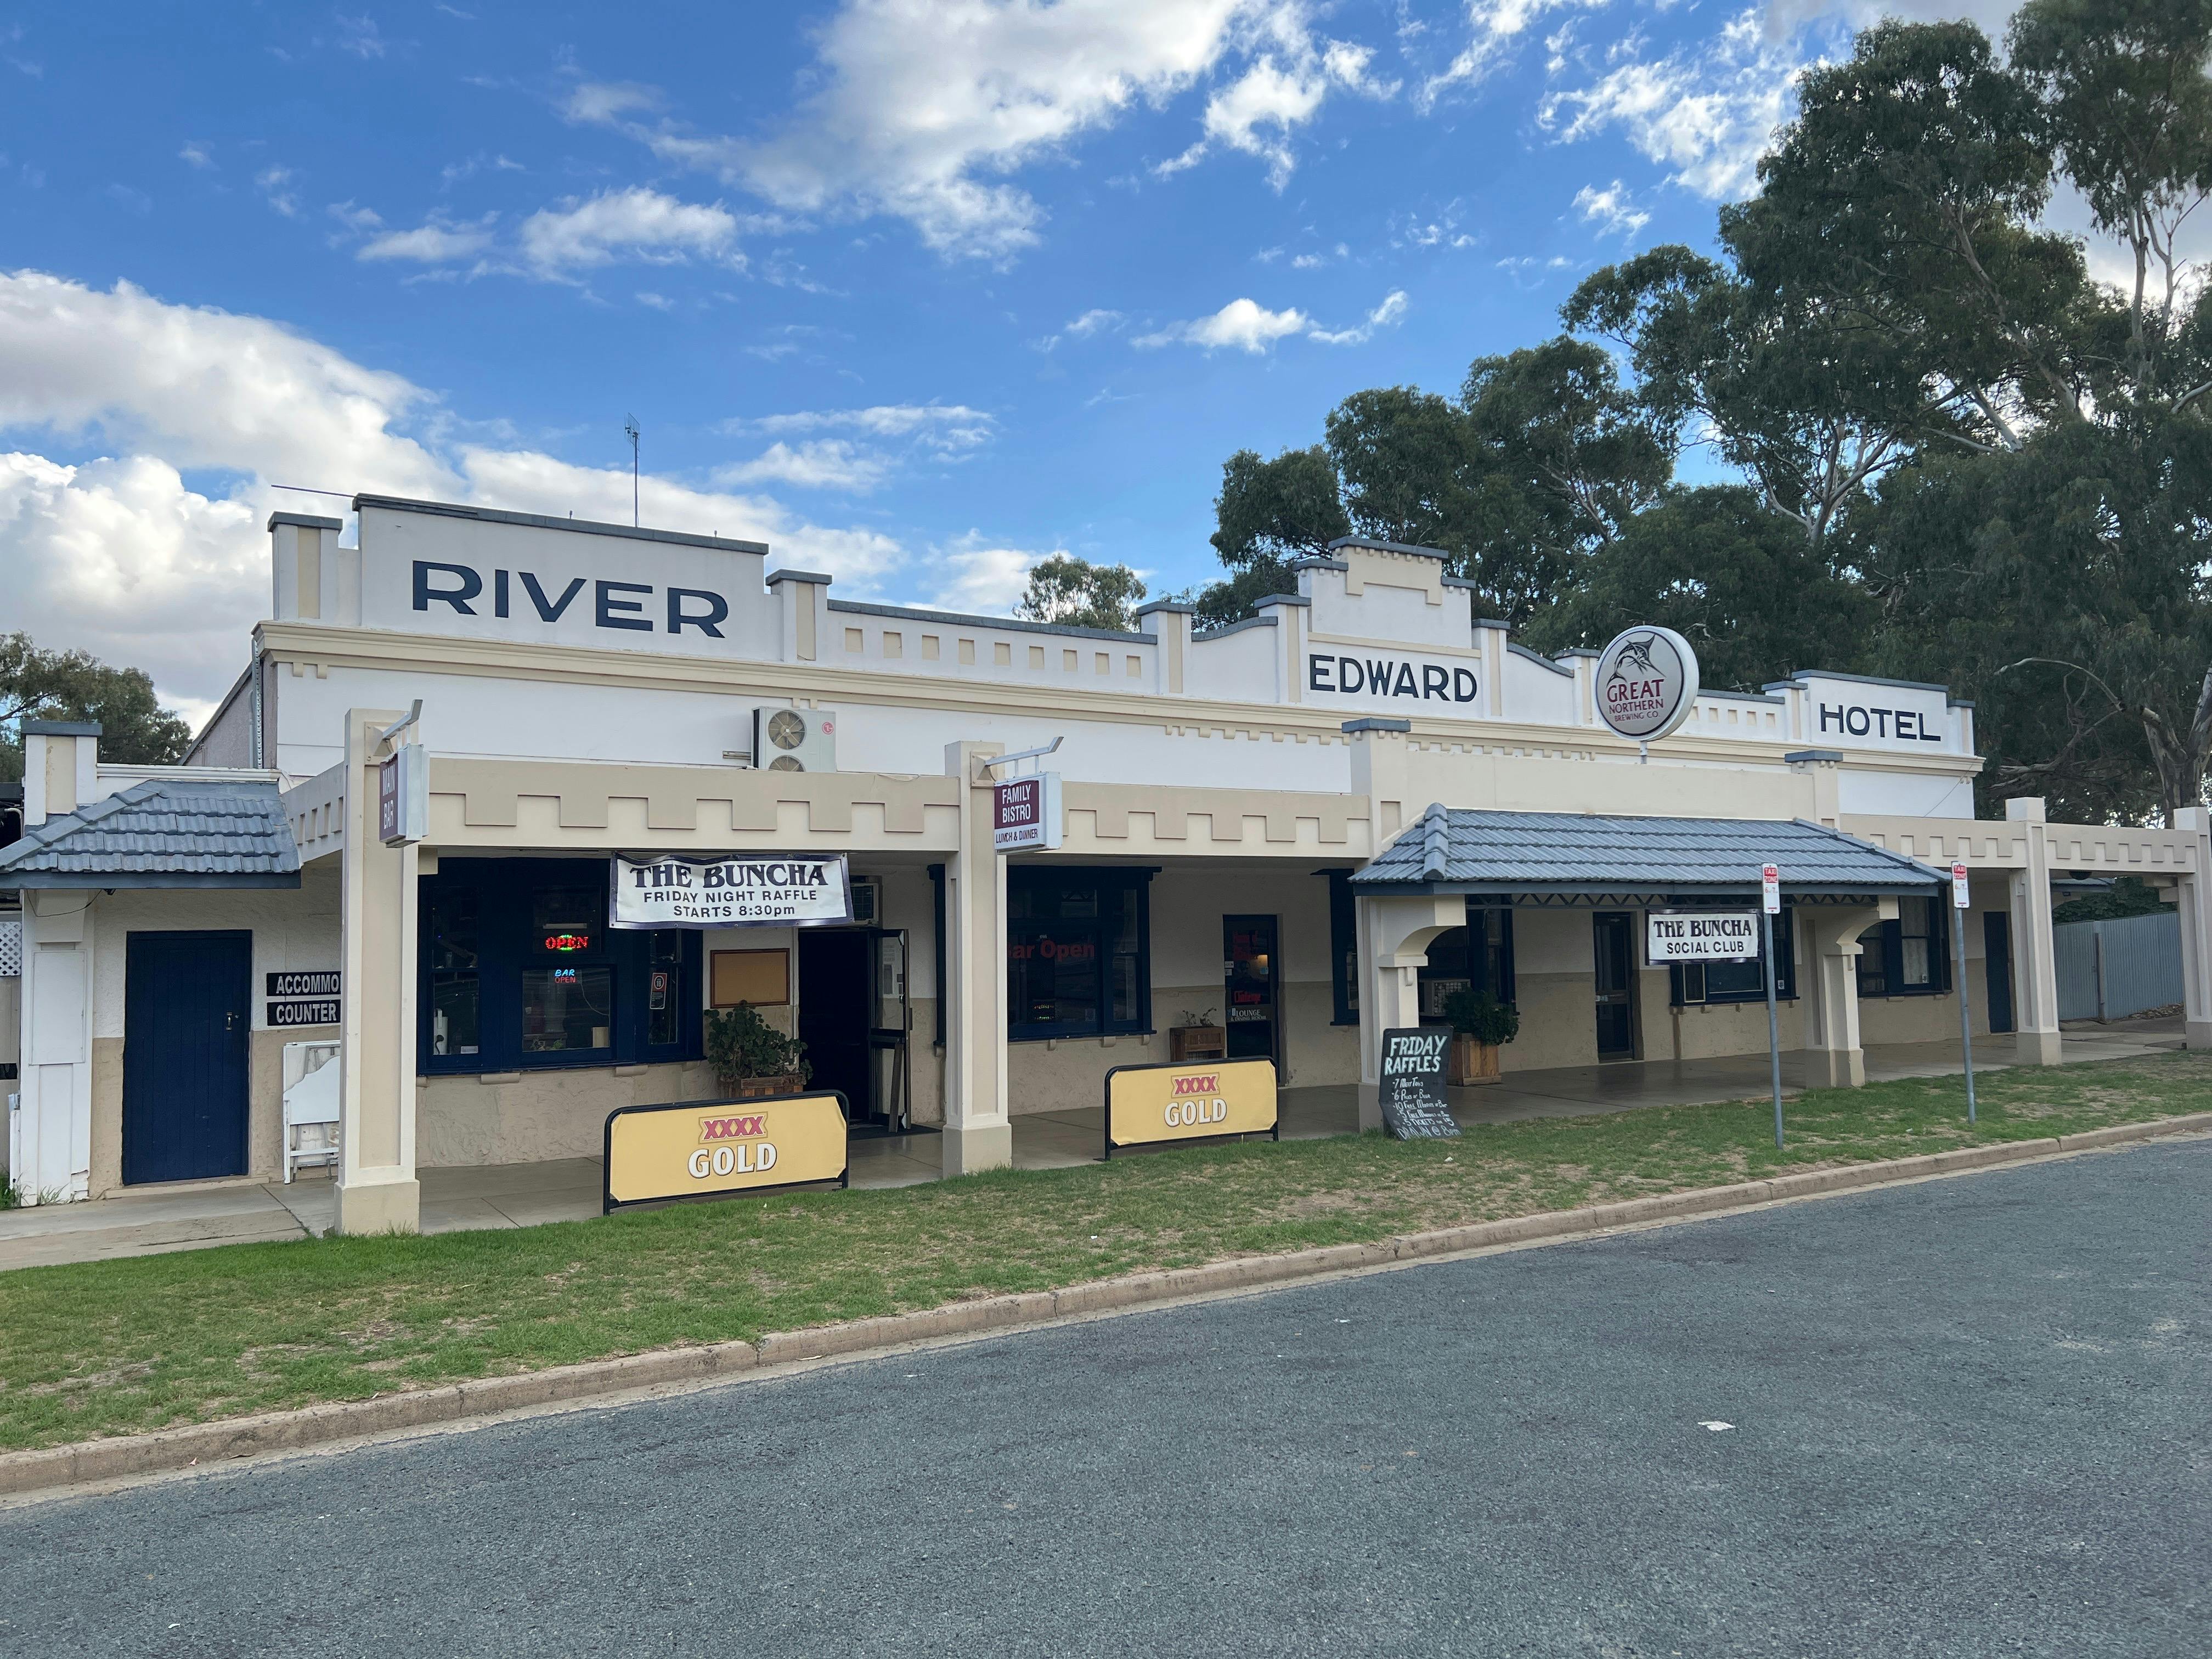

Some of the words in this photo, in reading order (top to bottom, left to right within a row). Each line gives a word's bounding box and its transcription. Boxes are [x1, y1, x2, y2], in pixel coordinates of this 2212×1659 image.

[413, 560, 729, 639] RIVER
[1309, 653, 1477, 702] EDWARD
[1607, 679, 1664, 703] GREAT
[1609, 698, 1663, 714] NORTHERN
[1614, 712, 1644, 722] BREWING
[1820, 703, 1941, 741] HOTEL
[382, 764, 396, 797] MAIN
[1002, 784, 1031, 805] FAMILY
[383, 799, 394, 830] BAR
[1002, 803, 1031, 823] BISTRO
[996, 831, 1013, 843] LUNCH
[1013, 831, 1018, 840] &
[1019, 828, 1038, 840] DINNER
[630, 864, 692, 888] THE
[703, 864, 828, 888] BUNCHA
[644, 890, 698, 903] FRIDAY
[706, 890, 755, 903] NIGHT
[762, 889, 817, 901] RAFFLE
[673, 905, 737, 918] STARTS
[738, 905, 795, 918] 8:30pm
[1653, 921, 1685, 938] THE
[1690, 919, 1752, 937] BUNCHA
[545, 936, 589, 949] OPEN
[1040, 939, 1095, 962] Open
[1667, 941, 1709, 954] SOCIAL
[1713, 941, 1744, 952] CLUB
[555, 969, 575, 977] BAR
[276, 1003, 337, 1023] COUNTER
[1236, 1009, 1261, 1017] LOUNGE
[1390, 1035, 1448, 1057] FRIDAY
[1384, 1056, 1441, 1075] RAFFLES
[1175, 1076, 1217, 1094] XXXX
[1164, 1098, 1227, 1127] GOLD
[703, 1115, 764, 1140] XXXX
[687, 1142, 777, 1179] GOLD
